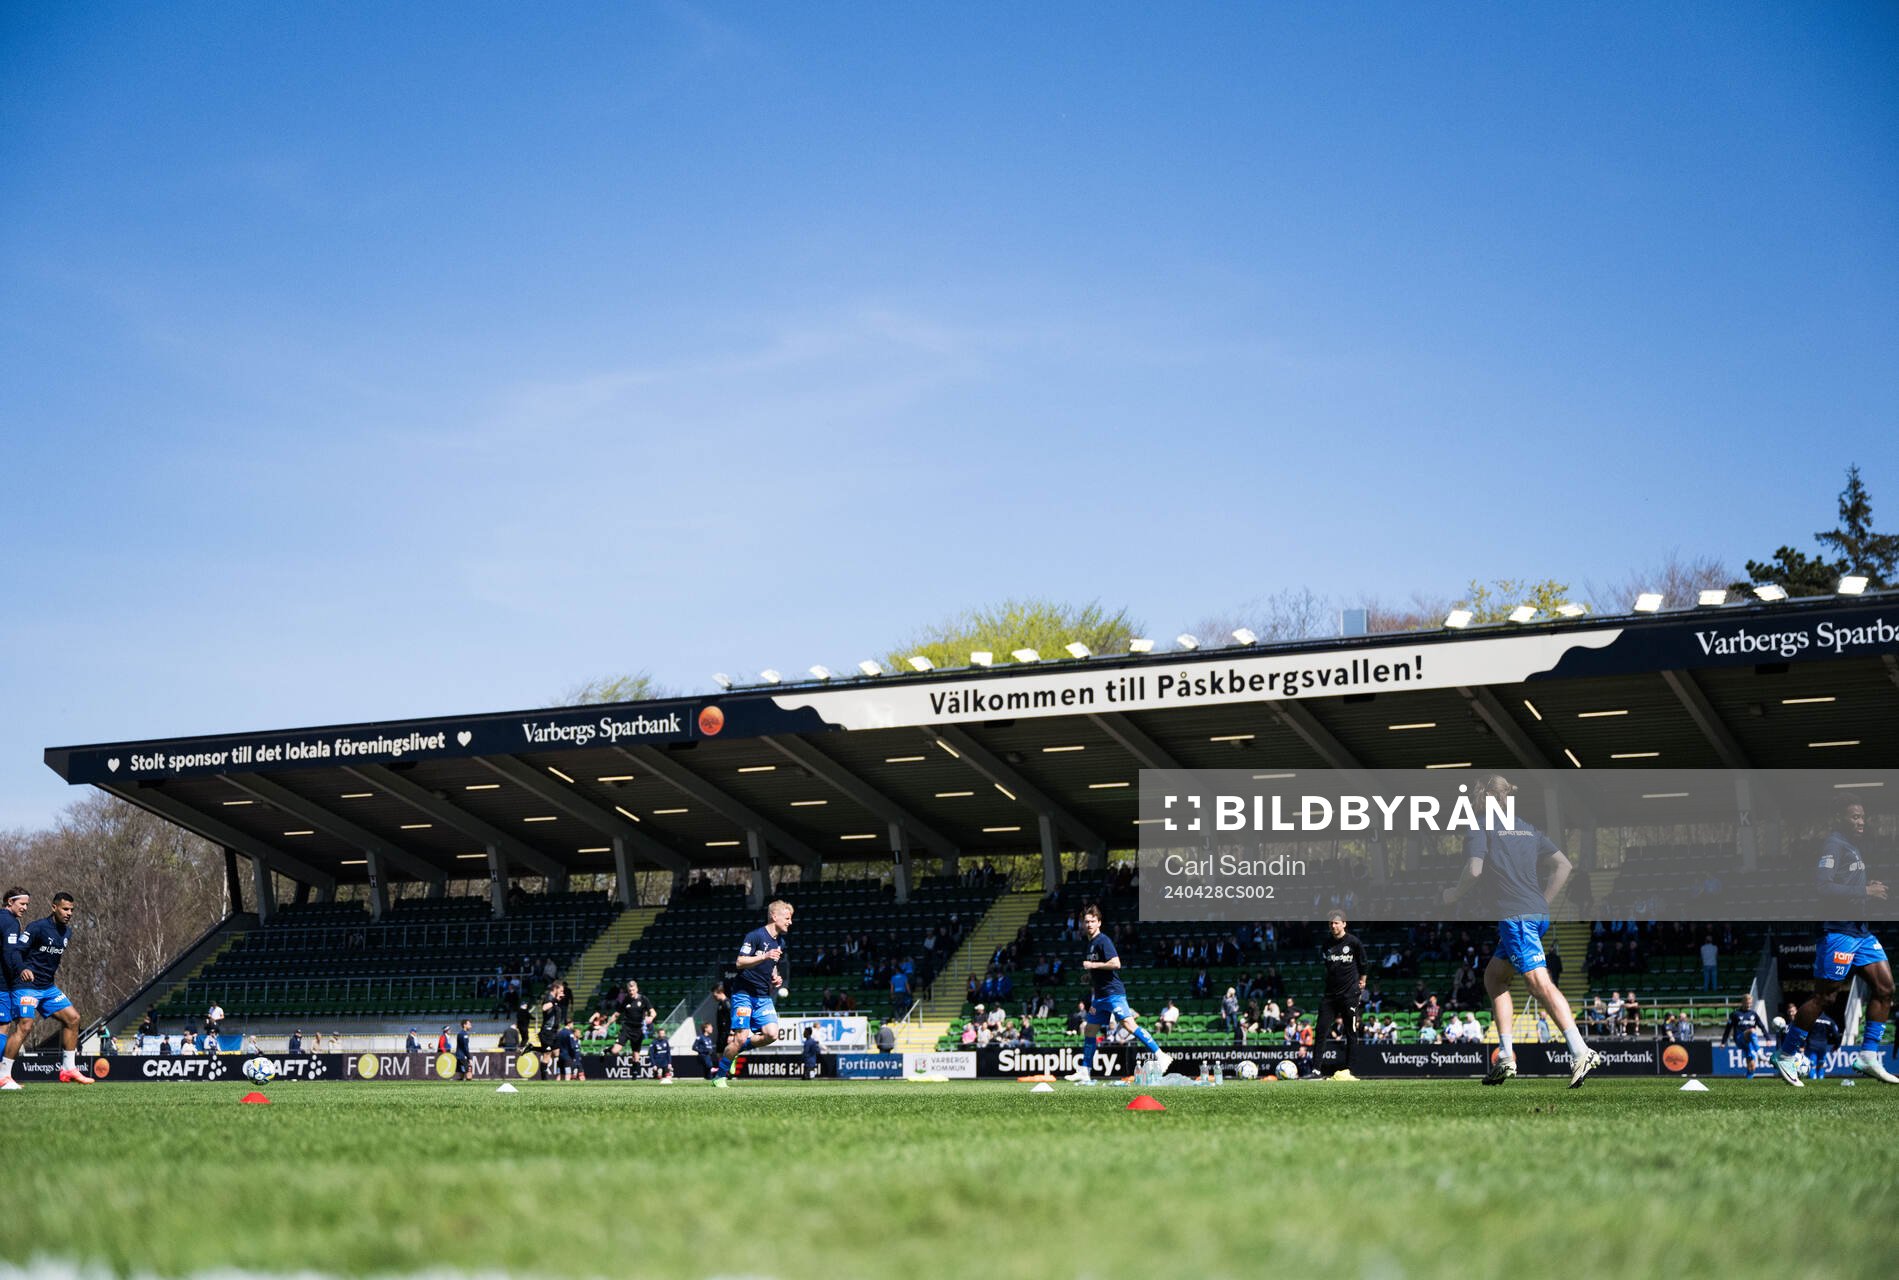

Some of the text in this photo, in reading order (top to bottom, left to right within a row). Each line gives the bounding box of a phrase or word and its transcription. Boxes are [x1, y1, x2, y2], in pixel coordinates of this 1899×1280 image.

[1695, 628, 1809, 657] Varbergs
[929, 655, 1424, 715] Välkommen till Påskbergsvallen!
[522, 712, 682, 745] Varbergs Sparbank
[130, 731, 446, 775] Stolt sponsor till det lokala föreningslivet
[778, 1023, 797, 1041] eri
[838, 1057, 898, 1070] Fortinova
[931, 1056, 969, 1064] VARBERGS
[998, 1047, 1121, 1077] Simplicty.
[1191, 1050, 1282, 1060] KAPITALFÖRVALTNING
[1381, 1051, 1483, 1067] Varbergs Sparbank
[1599, 1050, 1653, 1066] Sparbank
[22, 1062, 54, 1075] Varbergs
[142, 1059, 209, 1077] CRAFT
[748, 1063, 786, 1075] VARBERG
